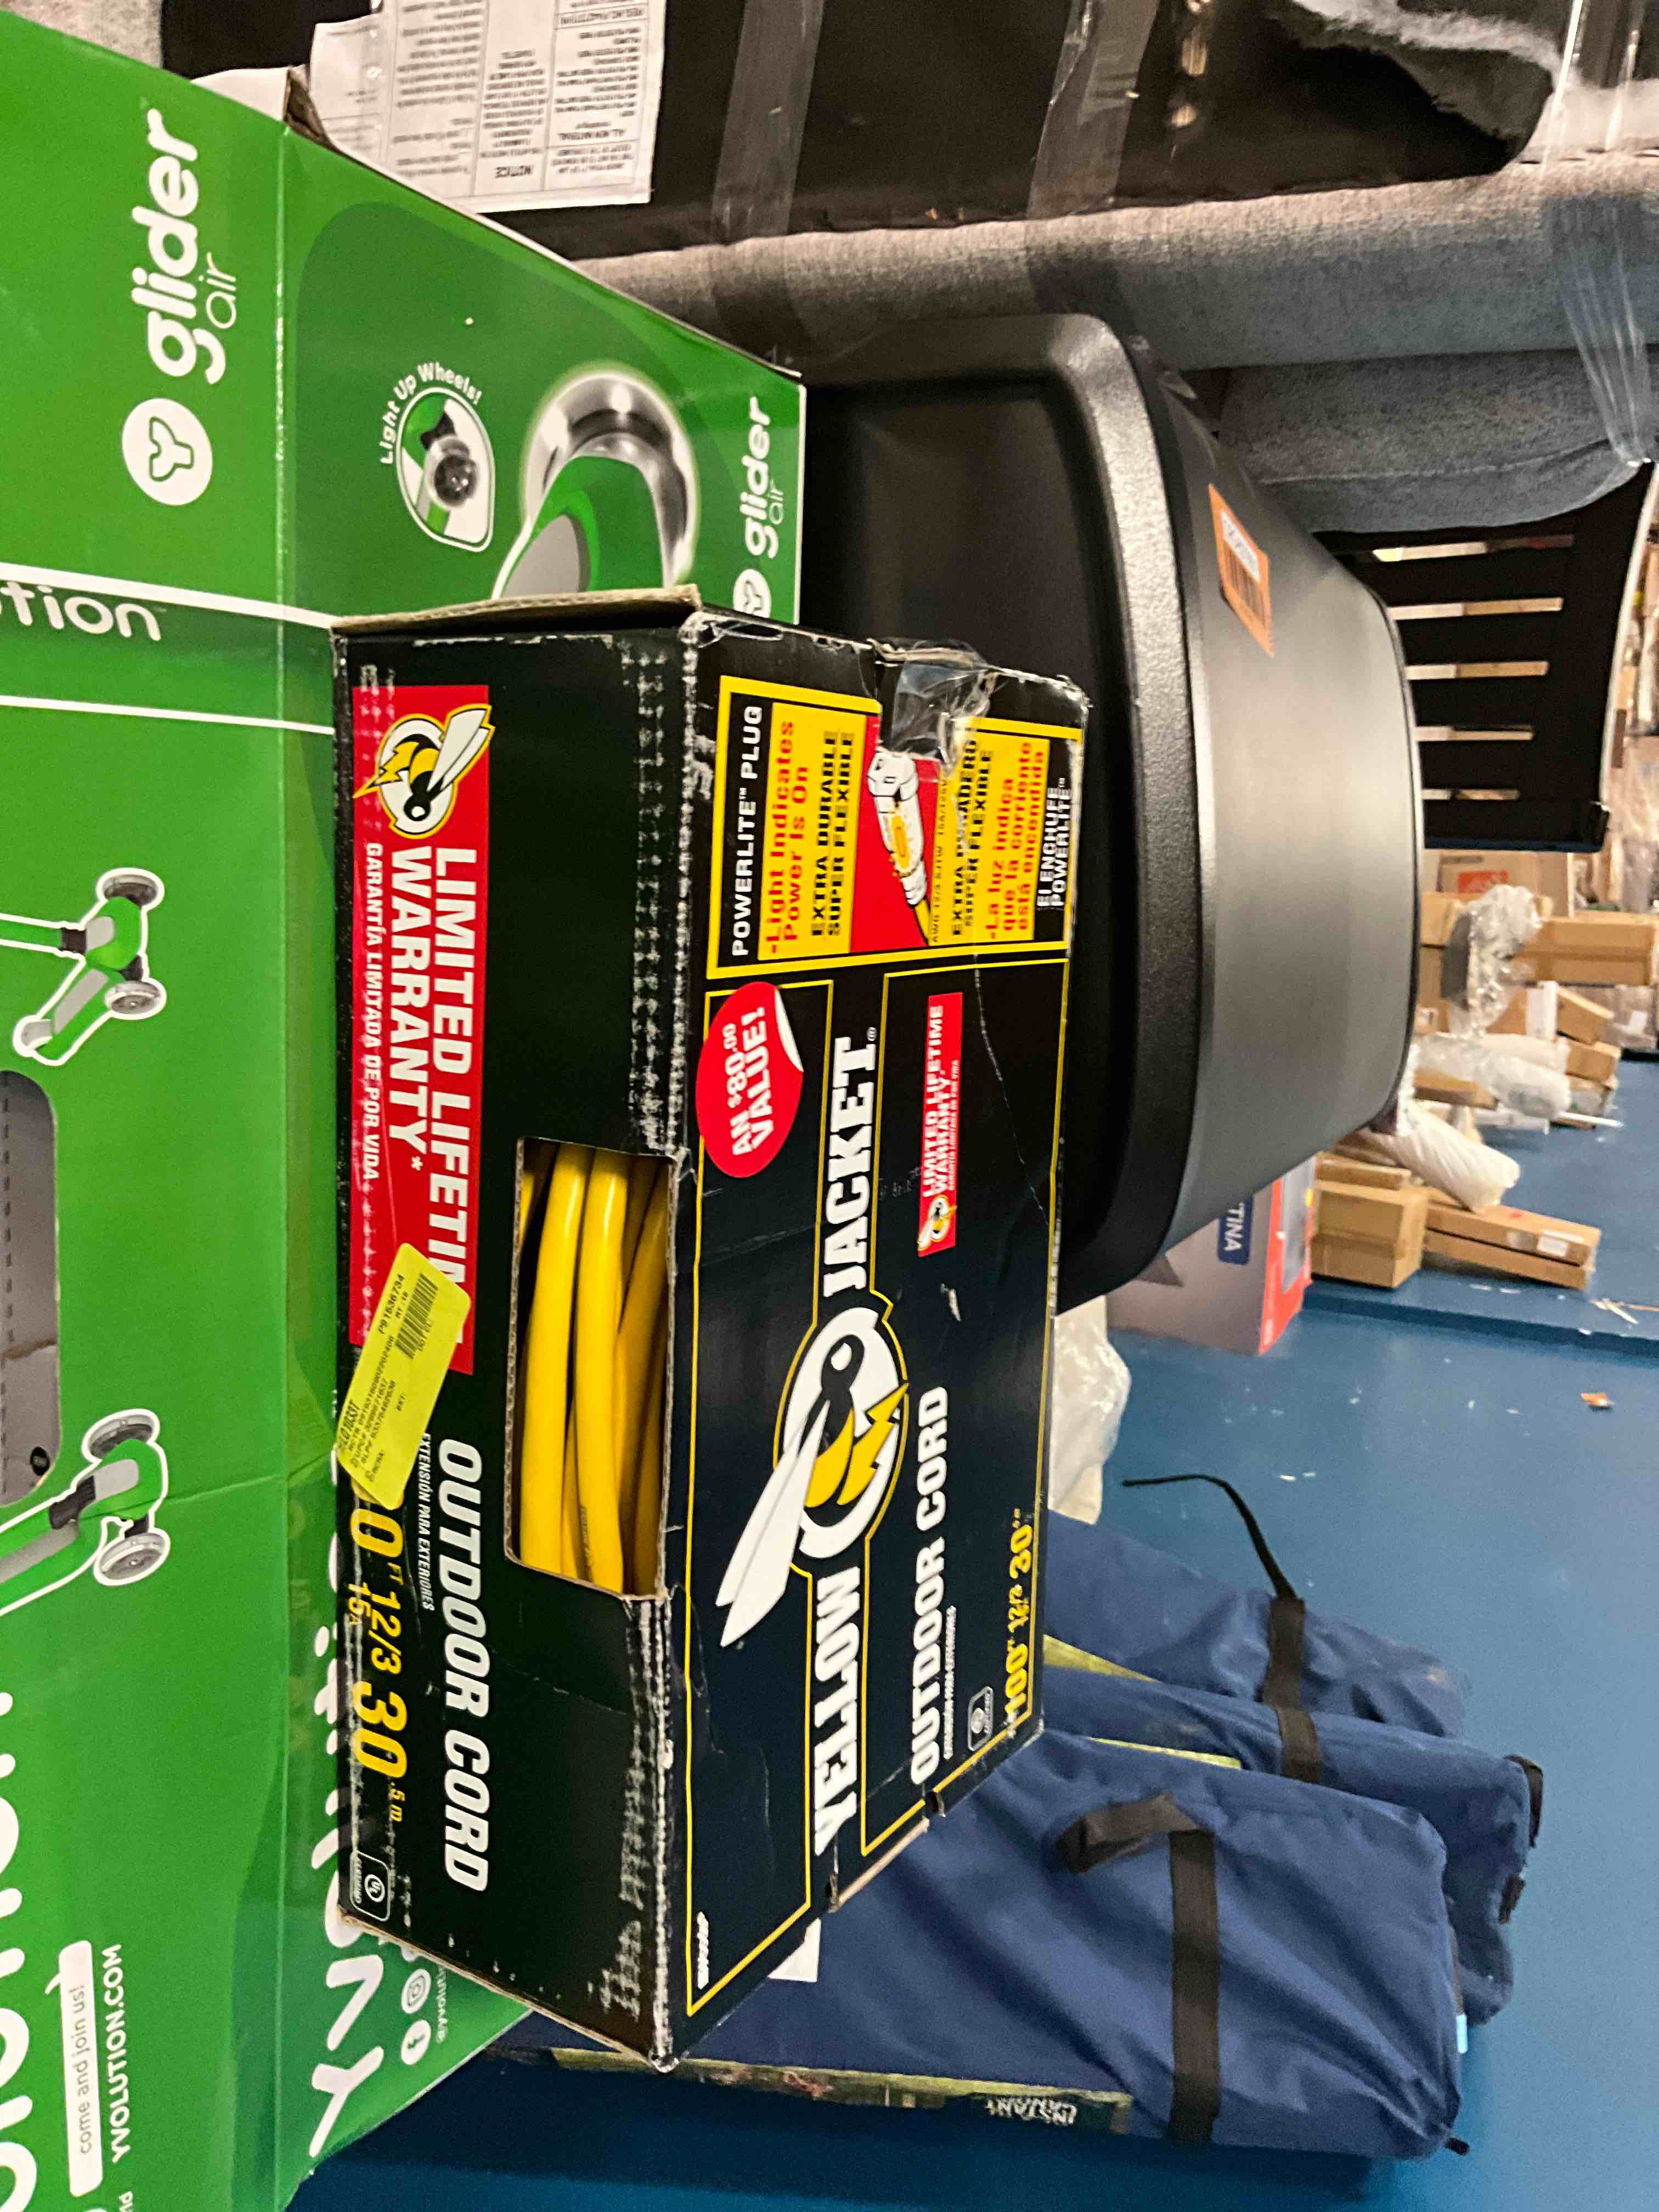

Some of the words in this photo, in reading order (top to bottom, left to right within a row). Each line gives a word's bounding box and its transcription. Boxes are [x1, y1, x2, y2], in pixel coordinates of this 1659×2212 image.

[131, 109, 227, 384] glider
[199, 252, 237, 329] air
[380, 399, 403, 464] Light
[393, 375, 418, 399] Up
[417, 359, 483, 404] Wheels!
[741, 397, 779, 559] glider
[770, 478, 785, 524] air
[0, 580, 161, 641] tion
[740, 706, 763, 780] PLUG
[770, 721, 794, 857] Indicates
[791, 766, 808, 804] On
[816, 731, 837, 847] DURABLE
[833, 732, 854, 848] FLEXIBLE
[969, 750, 992, 850] FLEXIBLE
[991, 777, 1014, 851] indica
[1007, 742, 1033, 850] corriente
[1022, 751, 1044, 873] encendida
[789, 816, 806, 840] Is
[1039, 787, 1059, 882] ENCHUFE
[365, 843, 387, 946] GARANTÍA
[783, 850, 803, 941] Power
[811, 856, 828, 936] EXTRA
[827, 856, 845, 936] SUPER
[951, 865, 964, 936] EXTRA
[964, 857, 979, 927] SUPER
[988, 859, 1003, 893] luz
[1003, 889, 1017, 931] que
[1005, 859, 1019, 880] la
[1017, 883, 1031, 931] está
[363, 952, 383, 1048] LIMITADA
[433, 848, 477, 1074] LIMITED
[363, 1054, 380, 1083] DE
[722, 1023, 748, 1109] $80.00
[741, 1006, 774, 1149] VALUE!
[926, 1005, 944, 1104] LIFETIME
[363, 1086, 380, 1128] POR
[730, 1110, 753, 1155] AN
[363, 1133, 380, 1181] VIDA
[823, 1036, 876, 1297] JACKET
[922, 1111, 939, 1198] LIMITED
[1223, 1202, 1245, 1251] TINA
[916, 1386, 948, 1531] CORD
[417, 1504, 431, 1534] PARA
[417, 1538, 435, 1611] EXTERIORES
[438, 1438, 490, 1717] OUTDOOR
[369, 1590, 402, 1674] 12/3
[910, 1537, 945, 1784] OUTDOOR
[814, 1566, 860, 1856] YELLOW
[444, 1729, 490, 1892] CORD
[68, 1985, 86, 2013] us!
[70, 2018, 92, 2056] join
[71, 2061, 90, 2096] and
[101, 1944, 132, 2162] YVOLUTION.COM
[75, 2102, 93, 2154] come
